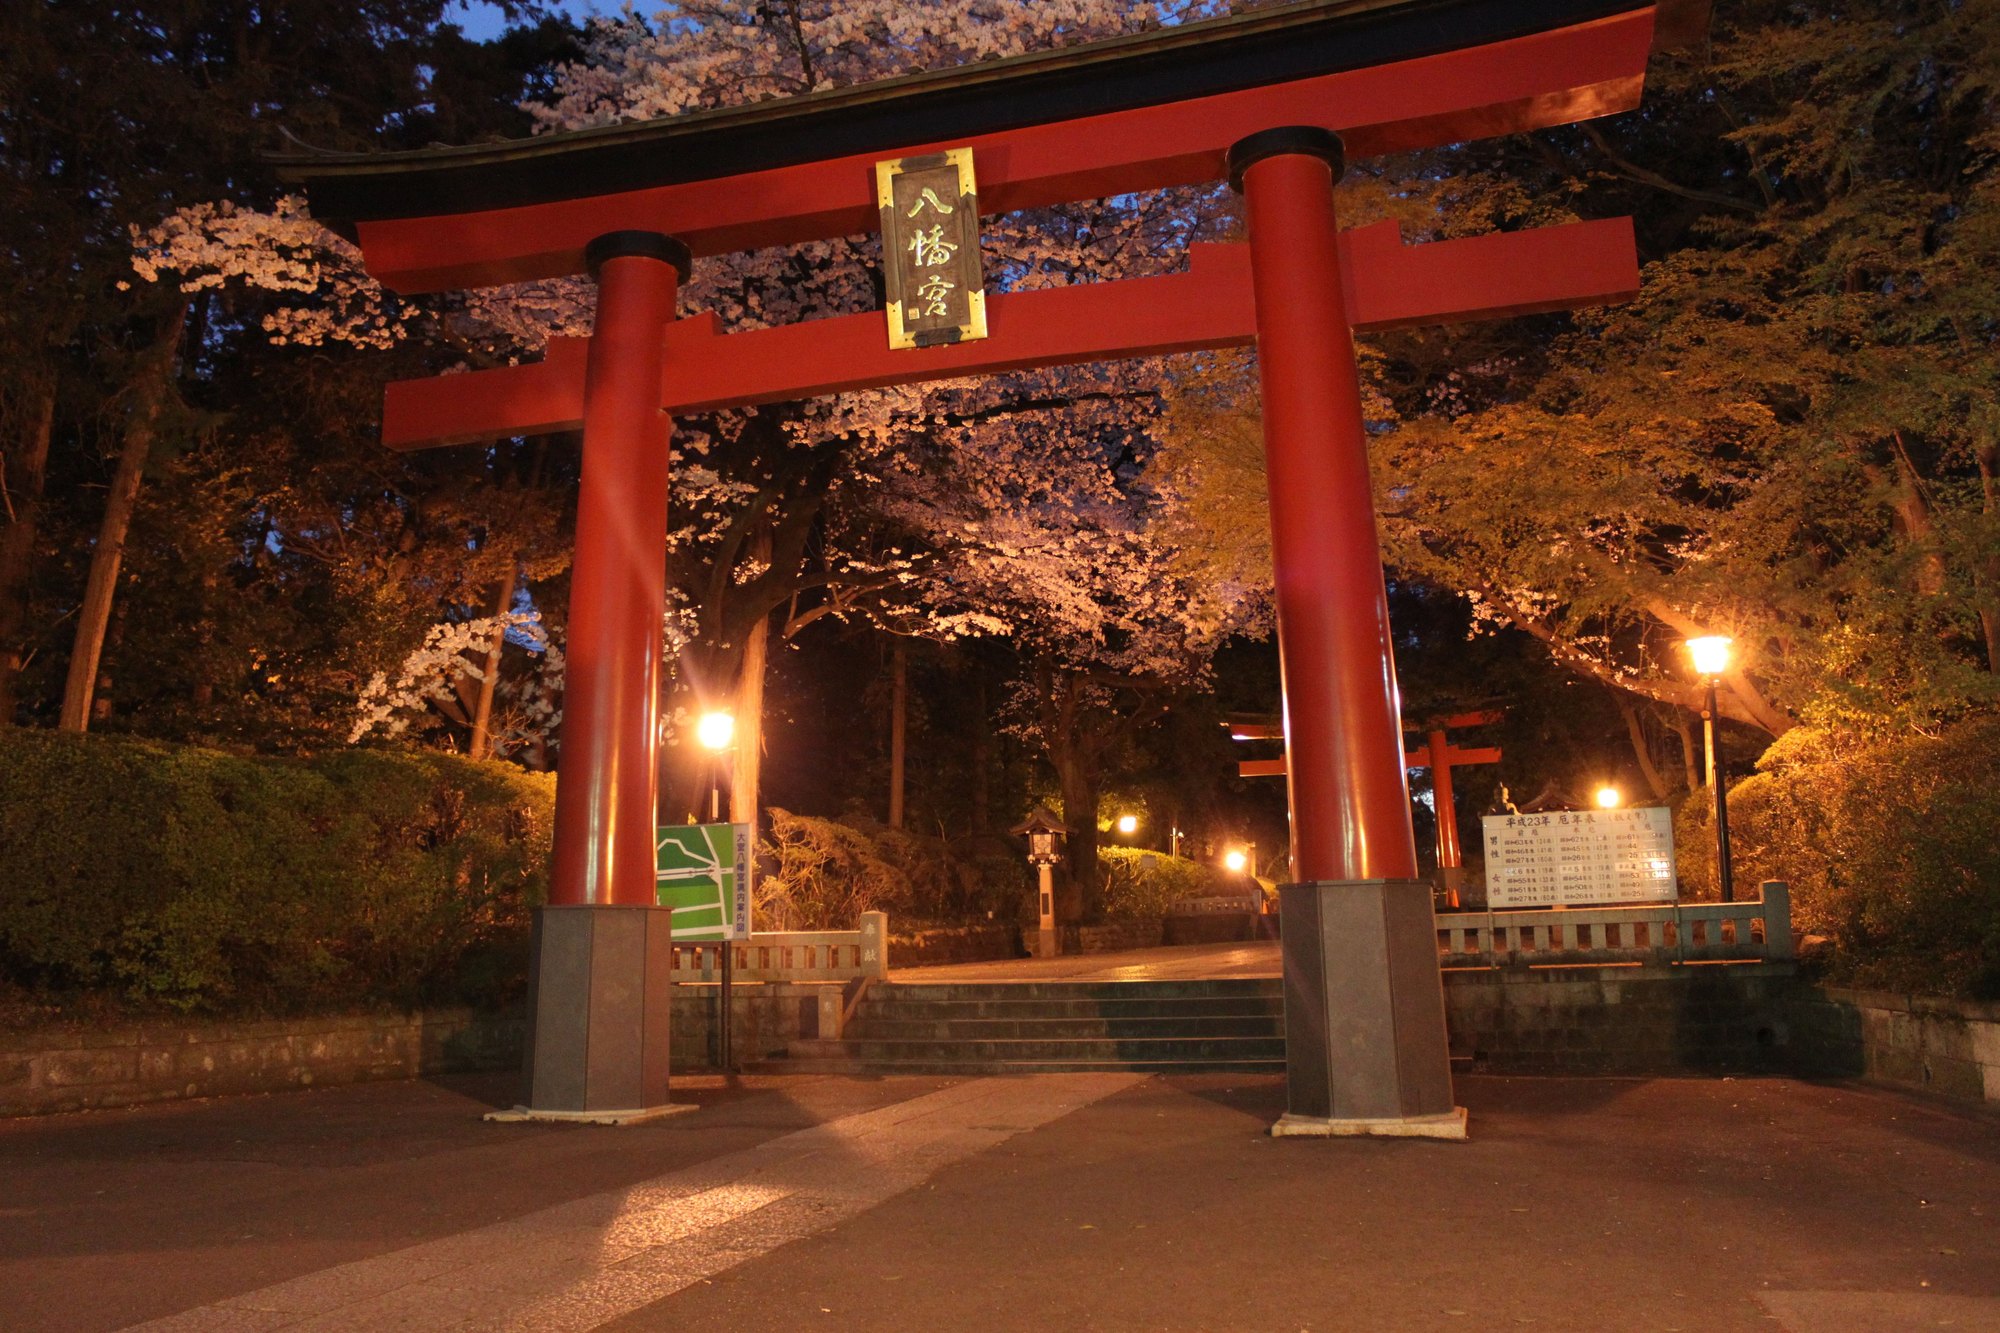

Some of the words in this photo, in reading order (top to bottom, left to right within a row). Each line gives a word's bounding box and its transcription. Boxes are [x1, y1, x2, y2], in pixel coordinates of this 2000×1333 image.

[907, 187, 958, 316] 八幡宮
[1506, 816, 1550, 828] 平成23年
[1558, 814, 1596, 824] 厄年表
